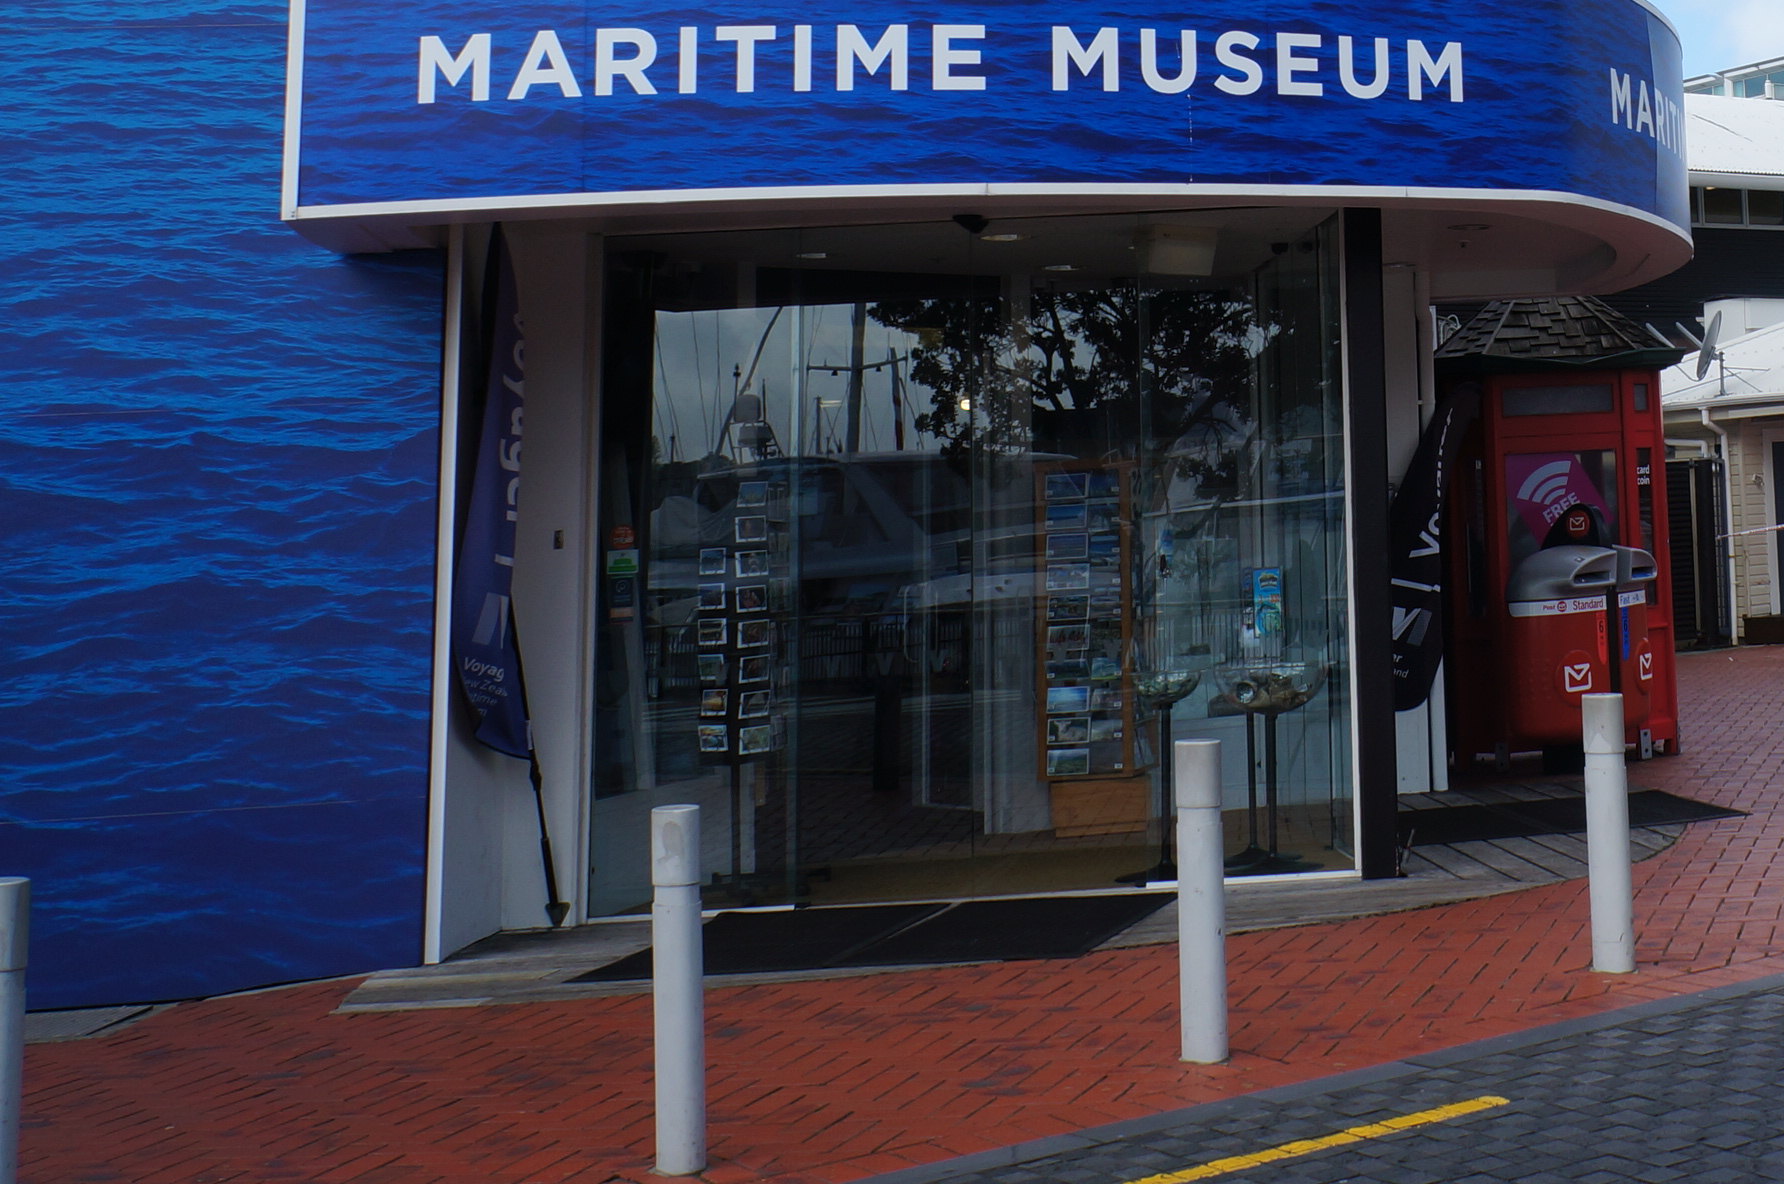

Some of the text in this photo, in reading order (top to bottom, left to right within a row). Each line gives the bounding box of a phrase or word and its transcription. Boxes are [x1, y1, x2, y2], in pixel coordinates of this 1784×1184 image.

[417, 23, 1464, 104] MARITIME MUSEUM
[1542, 492, 1581, 524] FREE
[1572, 599, 1604, 611] Standard
